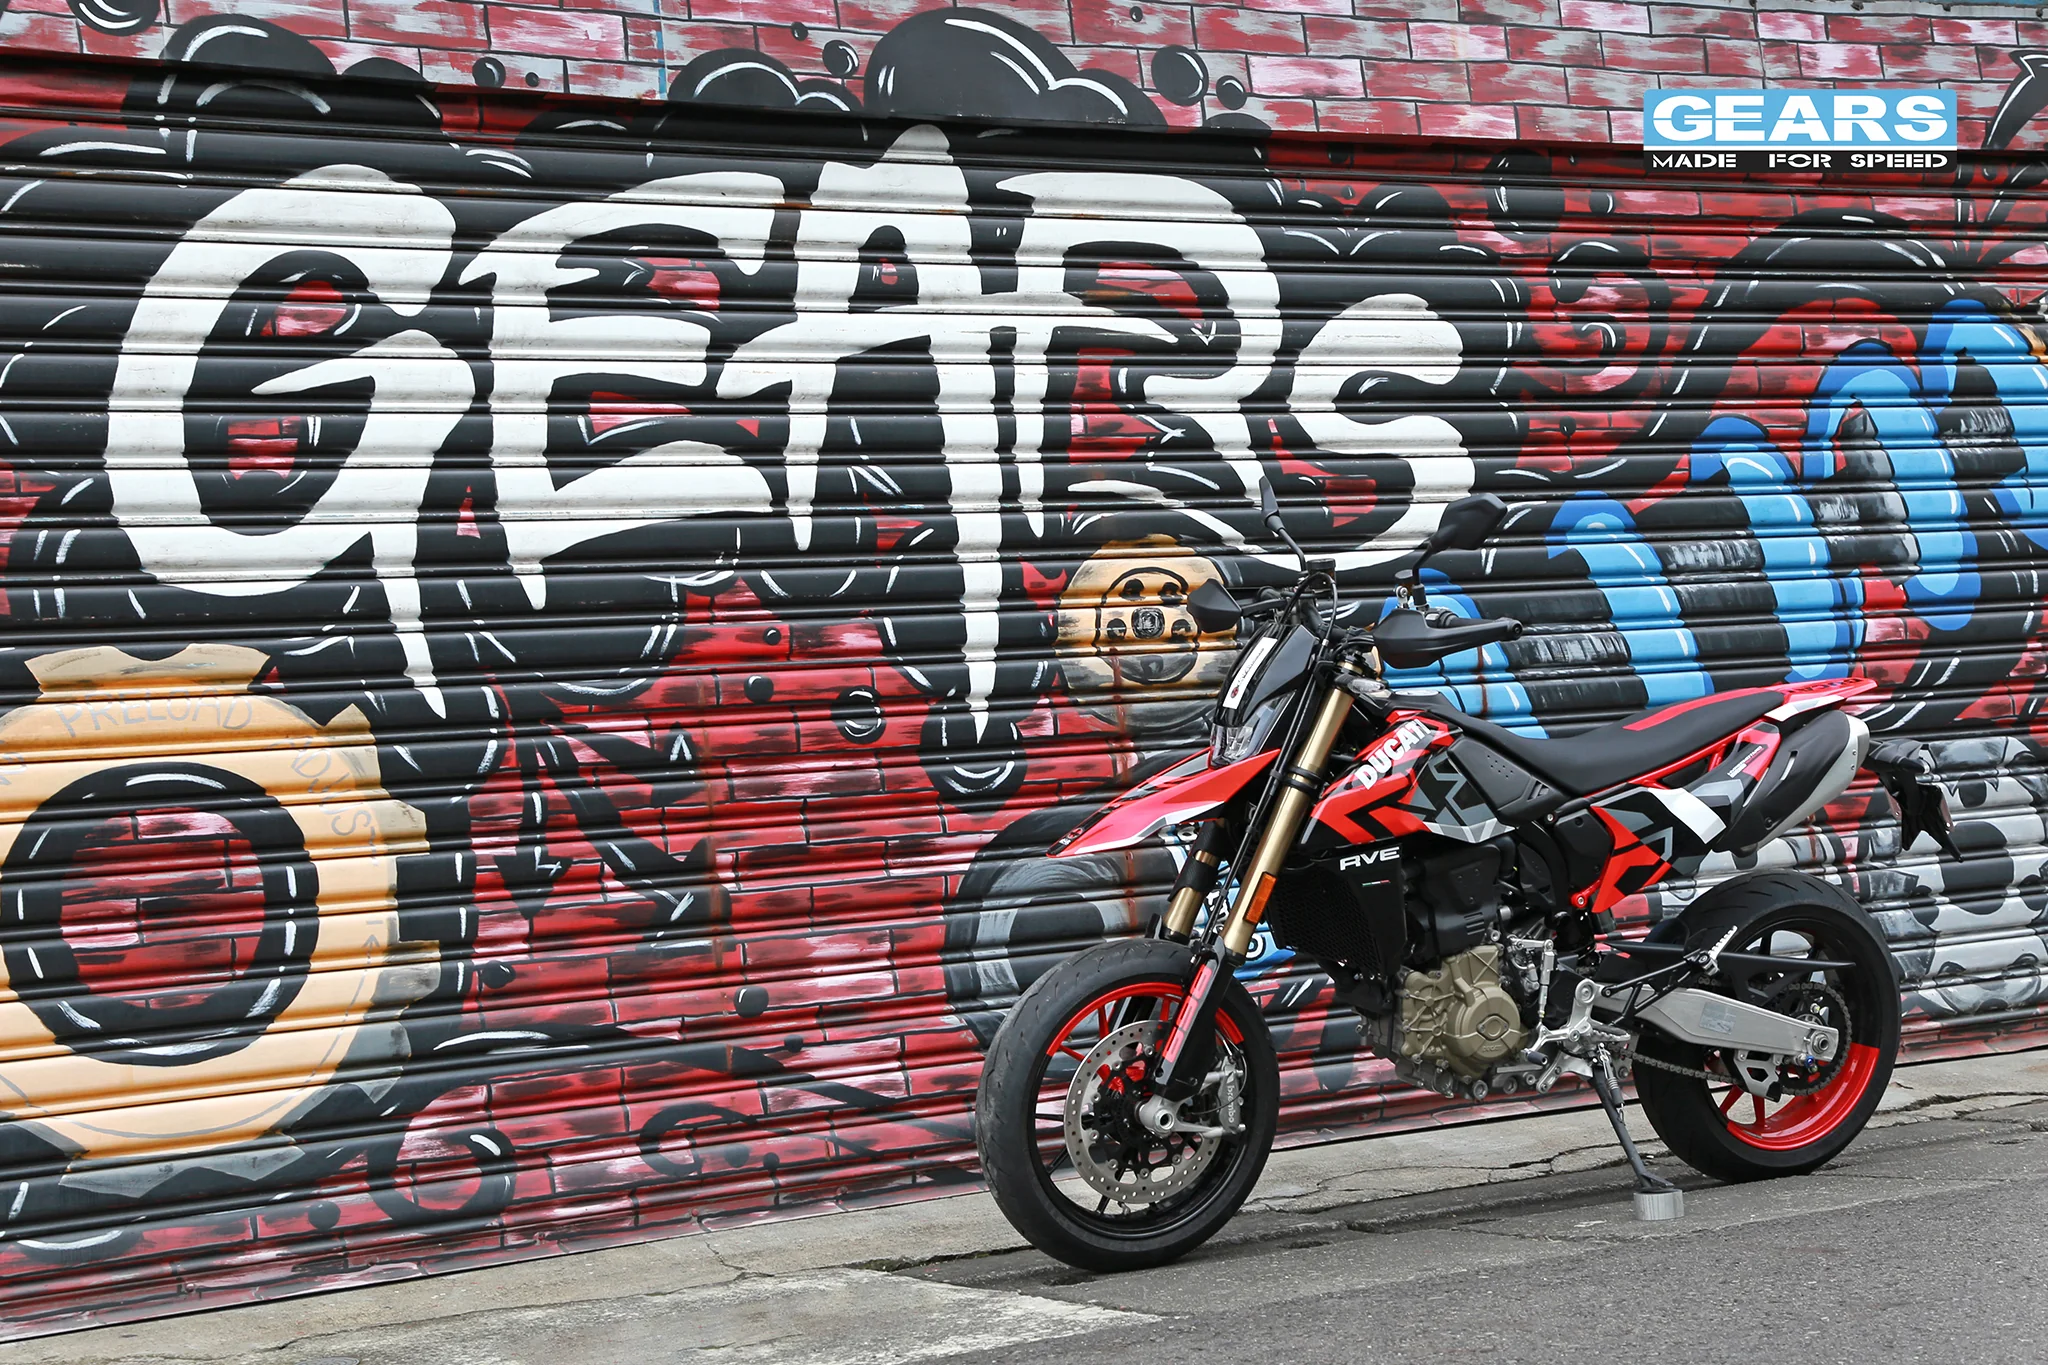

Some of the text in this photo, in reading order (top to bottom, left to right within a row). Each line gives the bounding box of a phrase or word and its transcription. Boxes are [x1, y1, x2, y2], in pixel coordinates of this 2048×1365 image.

[103, 123, 1476, 744] GEARS
[55, 688, 252, 738] PRELOAD
[1355, 718, 1431, 790] DUCATI
[1227, 1085, 1236, 1123] brembo
